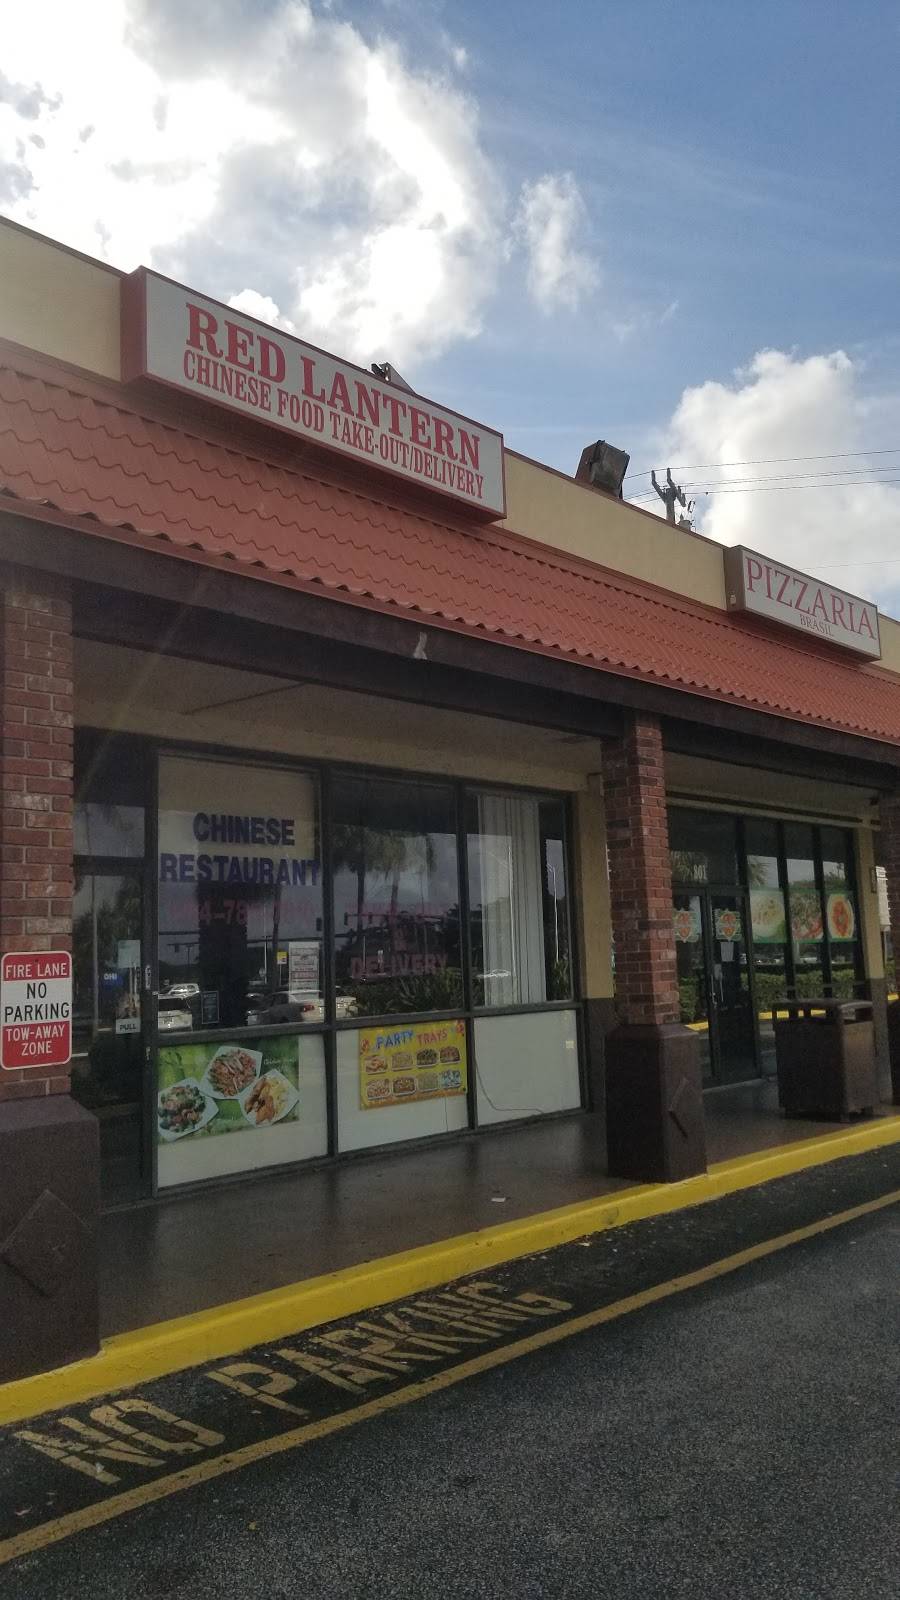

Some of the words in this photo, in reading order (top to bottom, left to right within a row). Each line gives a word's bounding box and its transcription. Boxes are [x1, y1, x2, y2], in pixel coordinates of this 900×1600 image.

[185, 302, 286, 383] RED
[301, 355, 481, 471] LANTERN
[183, 349, 272, 412] CHINESE
[277, 388, 325, 433] FOOD
[330, 411, 484, 499] TAKE-OUT/DELIVERY
[746, 556, 877, 640] PIZZARIA
[799, 613, 835, 637] BRASIL
[193, 812, 296, 846] CHINESE
[160, 853, 321, 886] RESTAURANT
[5, 964, 32, 979] FIRE
[37, 962, 68, 977] LANE
[350, 951, 448, 978] DELIVERY
[26, 982, 47, 999] NO
[5, 1002, 70, 1023] PARKING
[6, 1024, 65, 1042] TOW-AWAY
[376, 1029, 414, 1049] PARTY
[416, 1028, 448, 1047] TRAYS
[21, 1041, 52, 1057] ZONE
[13, 1398, 225, 1485] NO
[207, 1281, 573, 1417] PARKING
